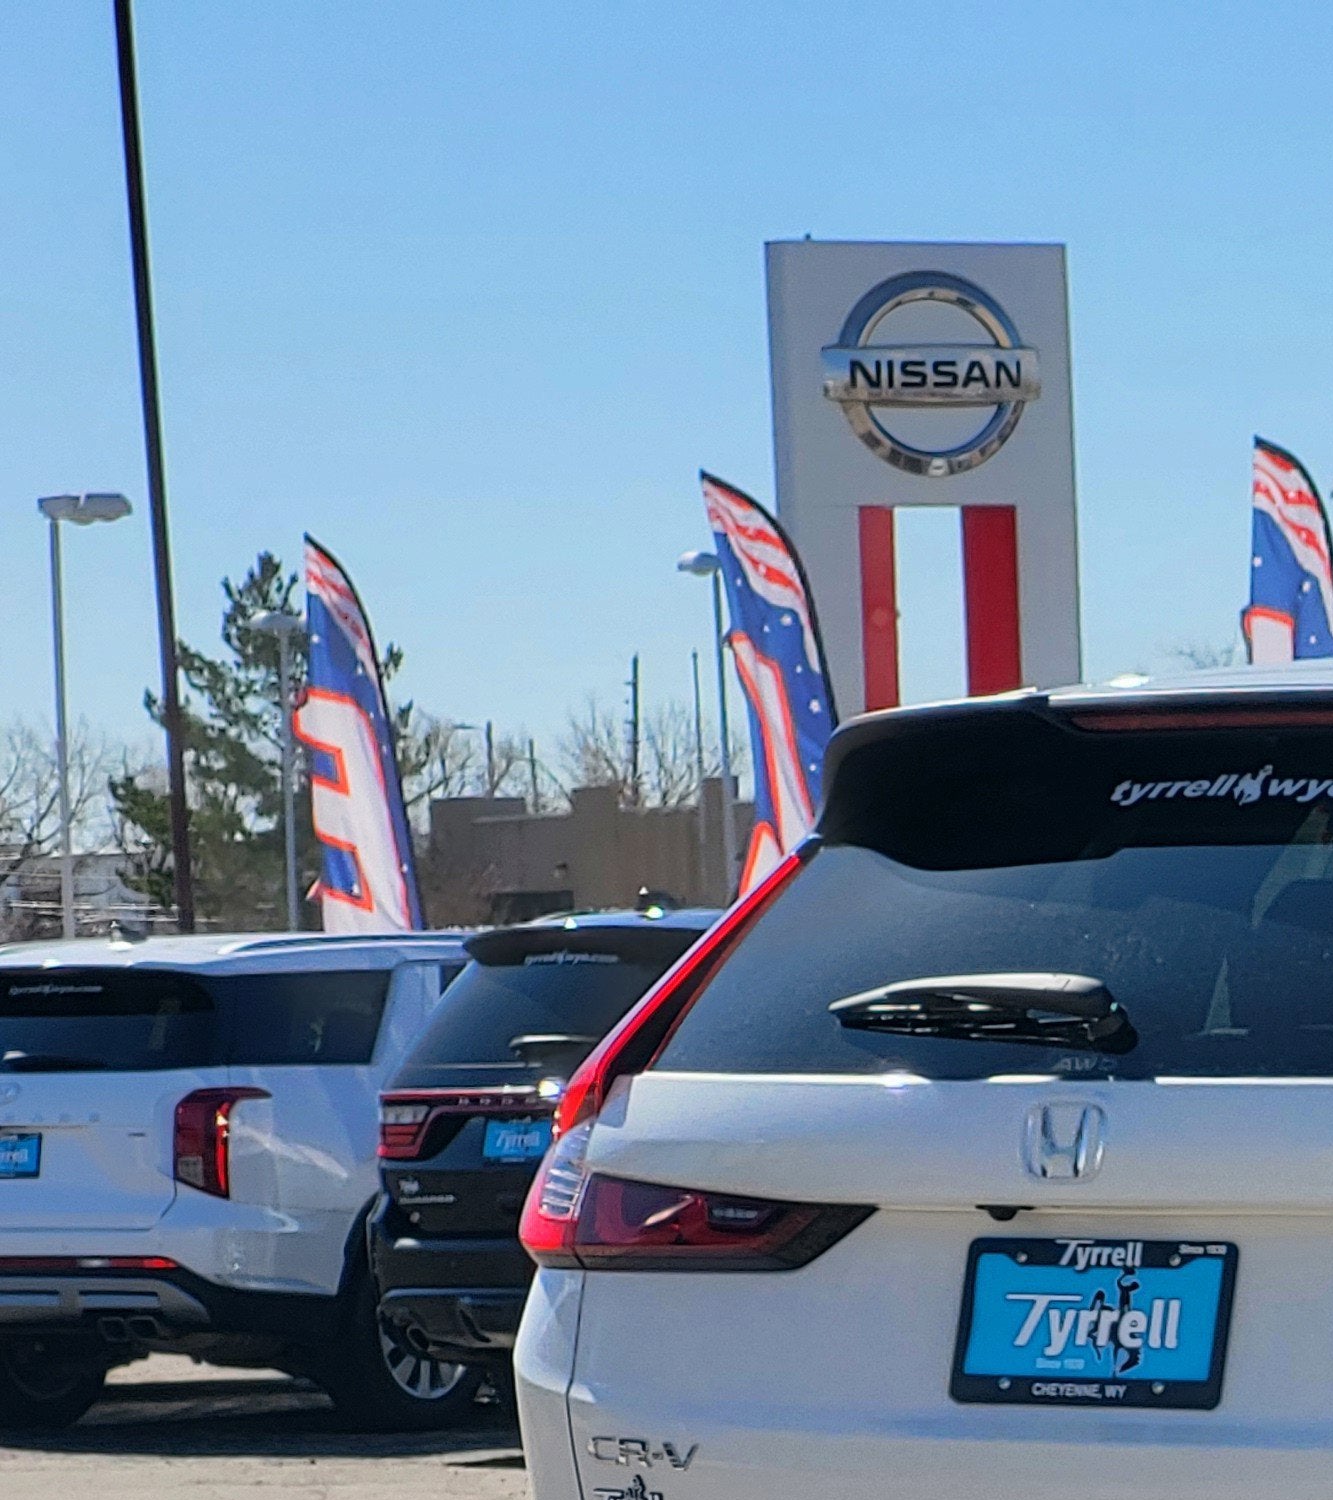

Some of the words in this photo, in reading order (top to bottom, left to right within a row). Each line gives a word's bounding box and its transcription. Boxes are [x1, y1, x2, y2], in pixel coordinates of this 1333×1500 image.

[848, 358, 1022, 390] NISSAN
[1054, 1239, 1144, 1271] Tyrrell
[1005, 1293, 1182, 1357] Tyrrell
[1104, 1384, 1128, 1399] WY
[587, 1436, 700, 1471] CR-V
